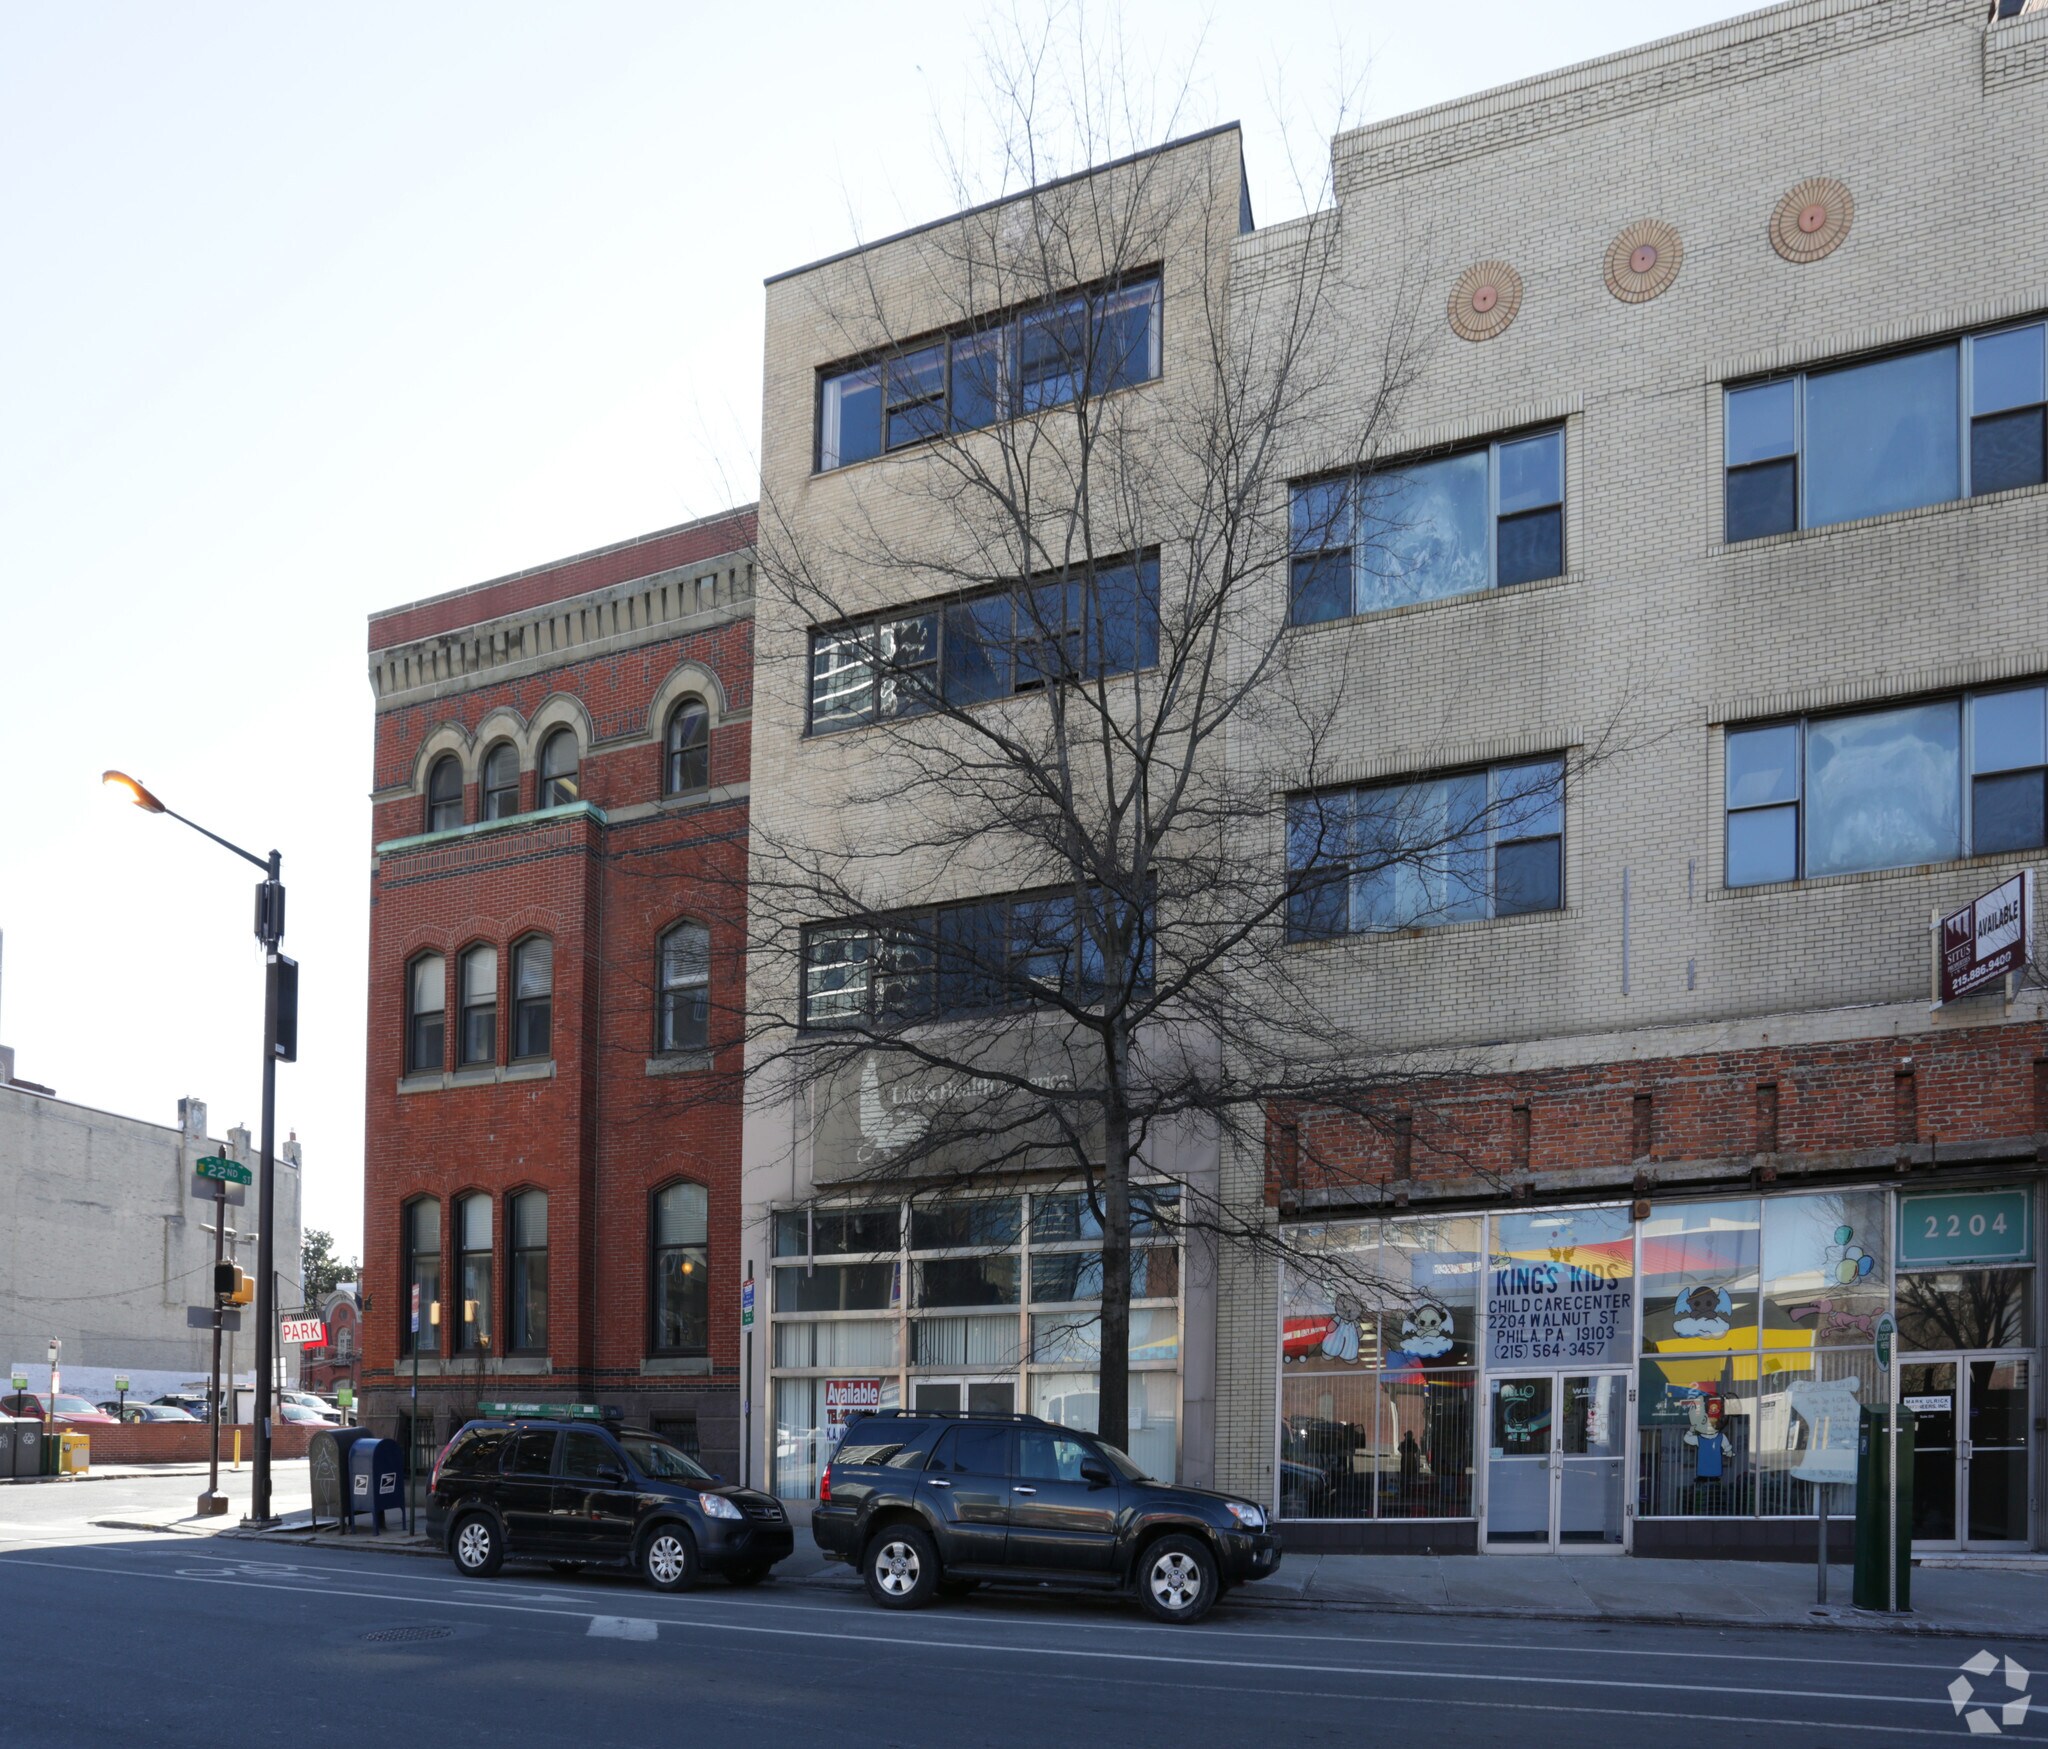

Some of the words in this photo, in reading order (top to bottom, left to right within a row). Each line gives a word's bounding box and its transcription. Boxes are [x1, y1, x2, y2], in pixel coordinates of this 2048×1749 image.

[1978, 899, 2018, 939] AVAILABLE
[1947, 943, 1971, 965] SITUS
[1952, 951, 2012, 990] 215.886.9400
[940, 1076, 994, 1099] Health
[208, 1164, 238, 1179] 22ND
[242, 1175, 252, 1184] ST
[1924, 1212, 2008, 1239] 2204
[1496, 1263, 1559, 1296] KING'S
[1570, 1263, 1619, 1293] KIDS
[1489, 1298, 1530, 1313] CHILD
[1534, 1296, 1572, 1312] CARE
[1574, 1293, 1631, 1310] CENTER
[1489, 1314, 1526, 1329] 2204
[1530, 1311, 1591, 1327] WALNUT
[1599, 1310, 1620, 1324] ST.
[283, 1321, 320, 1341] PARK
[1497, 1328, 1541, 1344] PHILA.
[1545, 1327, 1564, 1342] PA
[1577, 1326, 1615, 1341] 19103
[1494, 1344, 1529, 1359] (215)
[826, 1382, 878, 1404] Available
